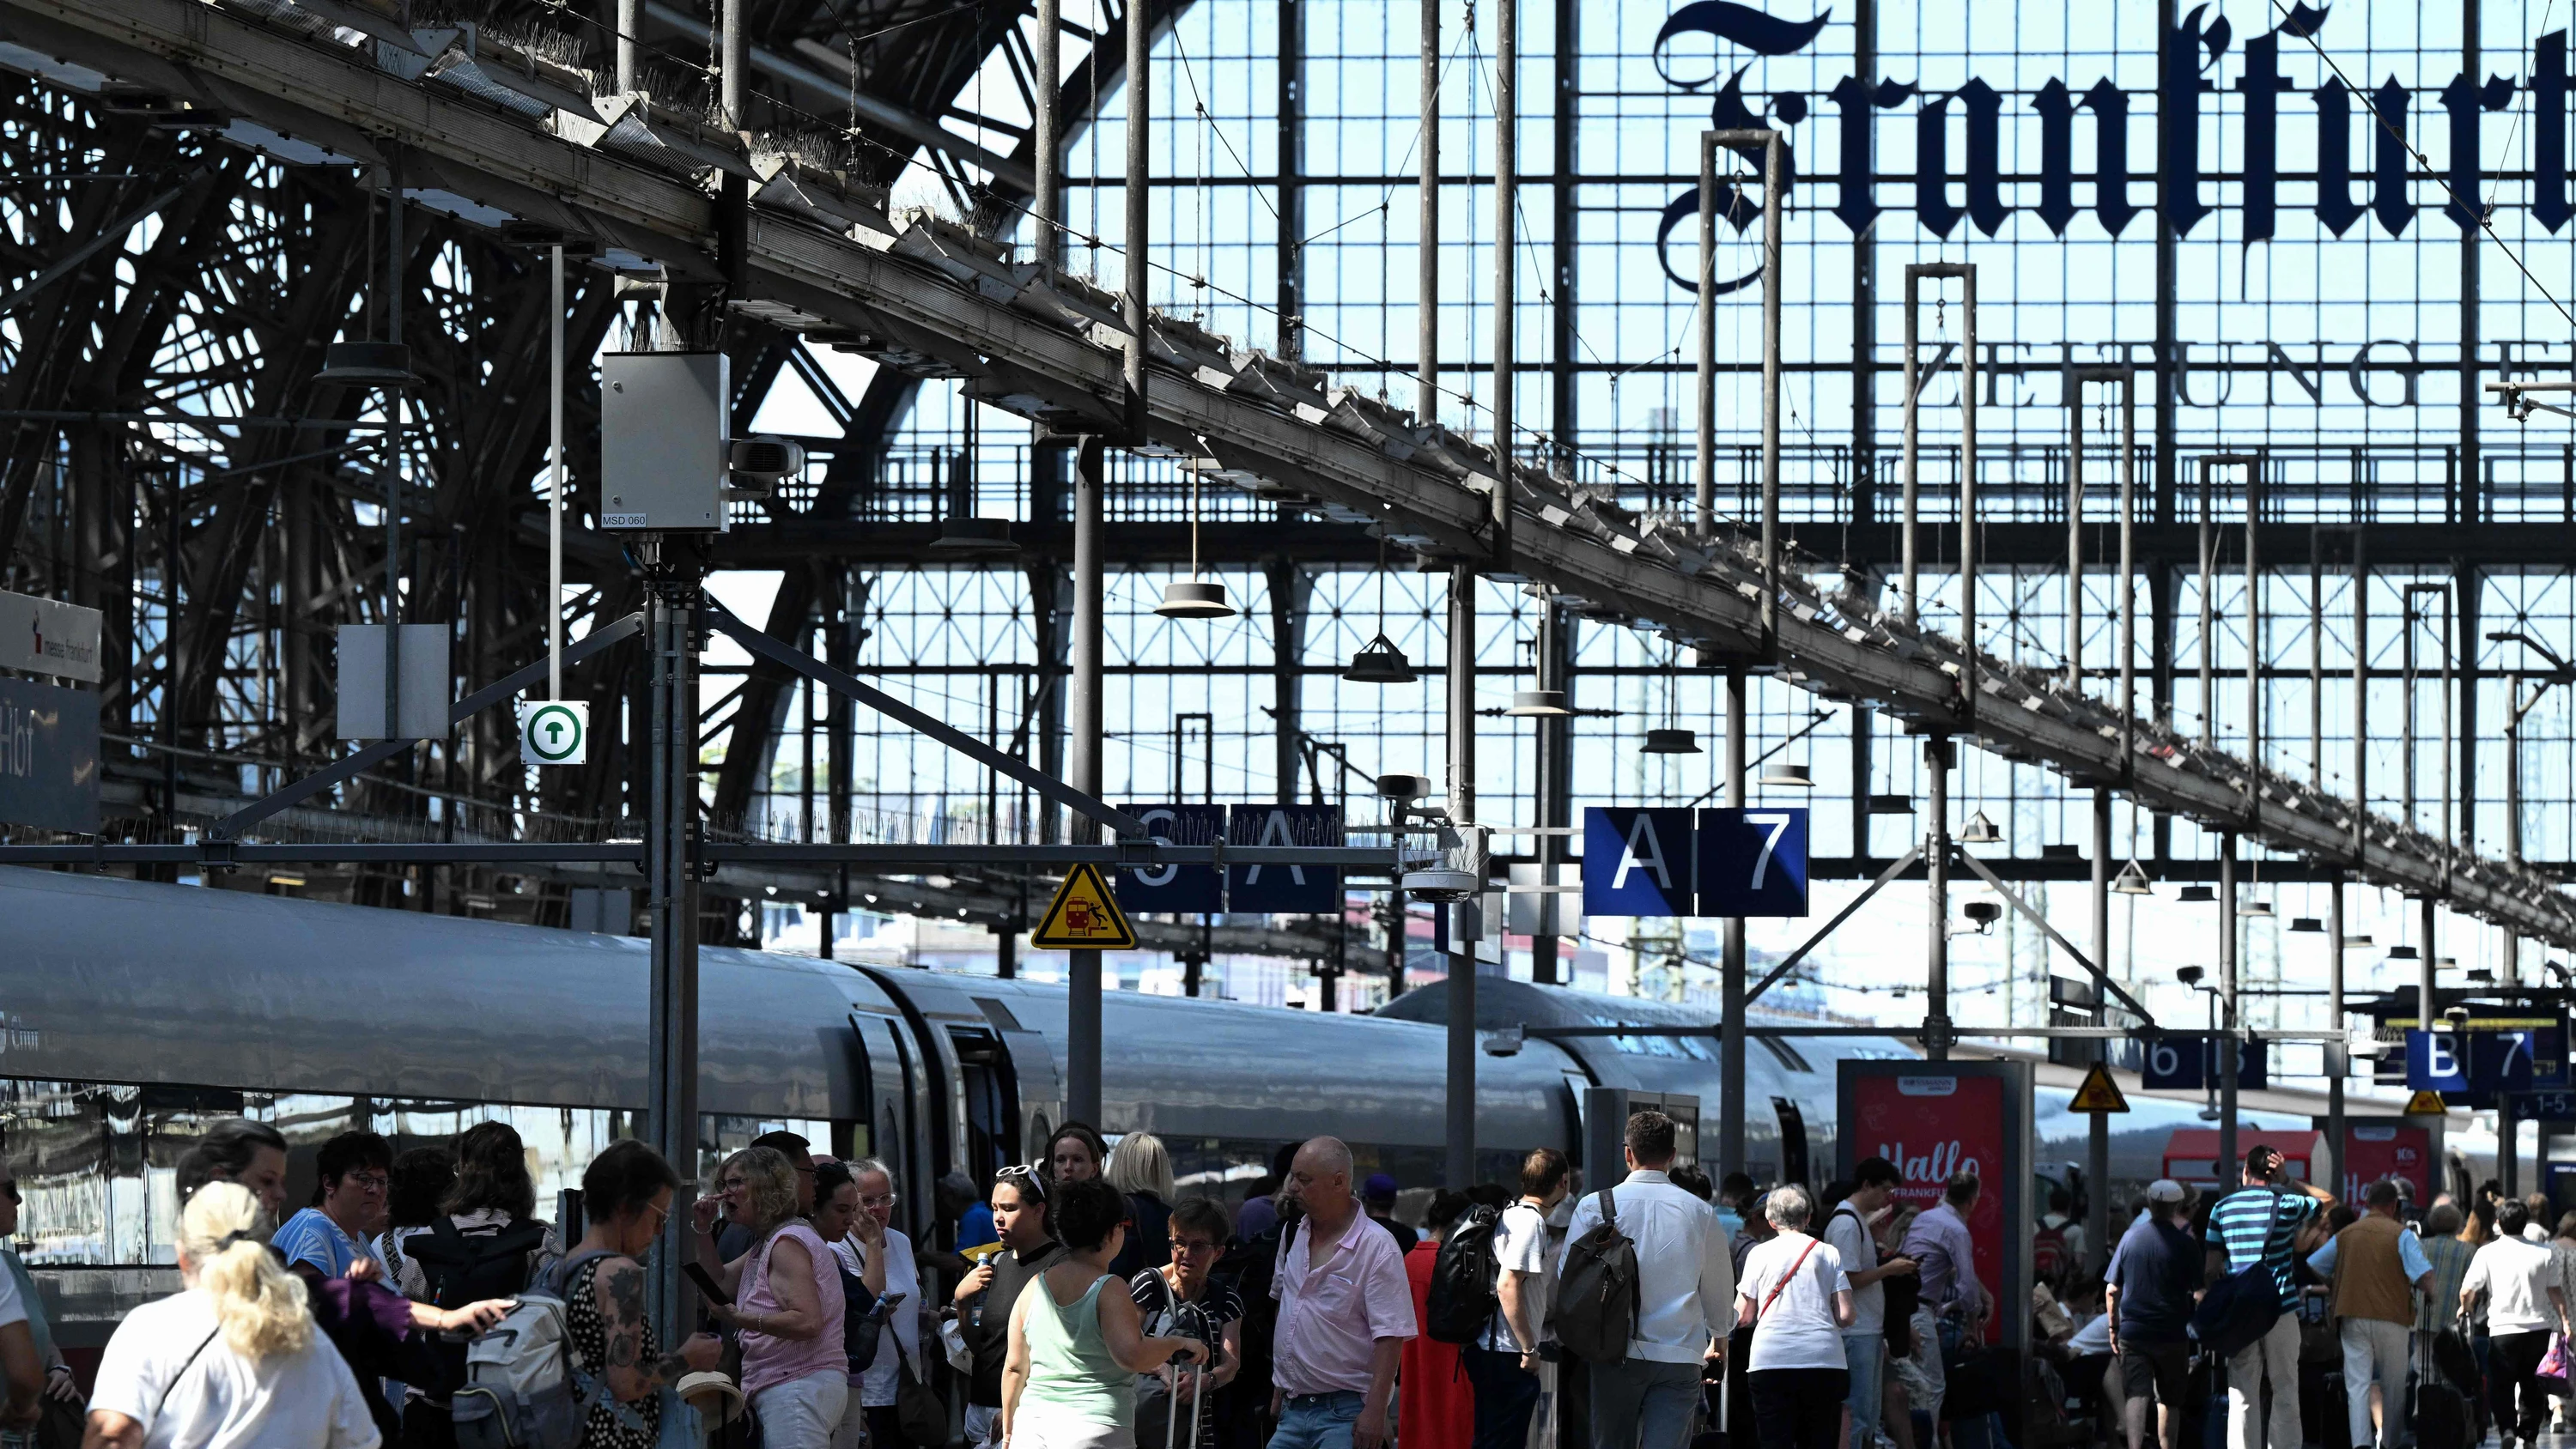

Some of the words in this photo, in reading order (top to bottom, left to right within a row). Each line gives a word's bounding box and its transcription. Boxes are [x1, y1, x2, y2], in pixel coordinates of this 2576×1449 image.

[1900, 339, 2424, 409] ZEITUNG
[603, 516, 625, 525] MSD
[628, 516, 646, 525] 060
[1245, 809, 1306, 885] A
[1612, 813, 1673, 889] A
[1742, 813, 1790, 889] 7
[2150, 1038, 2178, 1076] 6
[2428, 1032, 2459, 1077] B
[2496, 1033, 2524, 1076] 7
[2537, 1094, 2567, 1114] 1-5
[1879, 1140, 1980, 1184] Hallo
[1894, 1186, 1948, 1199] FRANKFU
